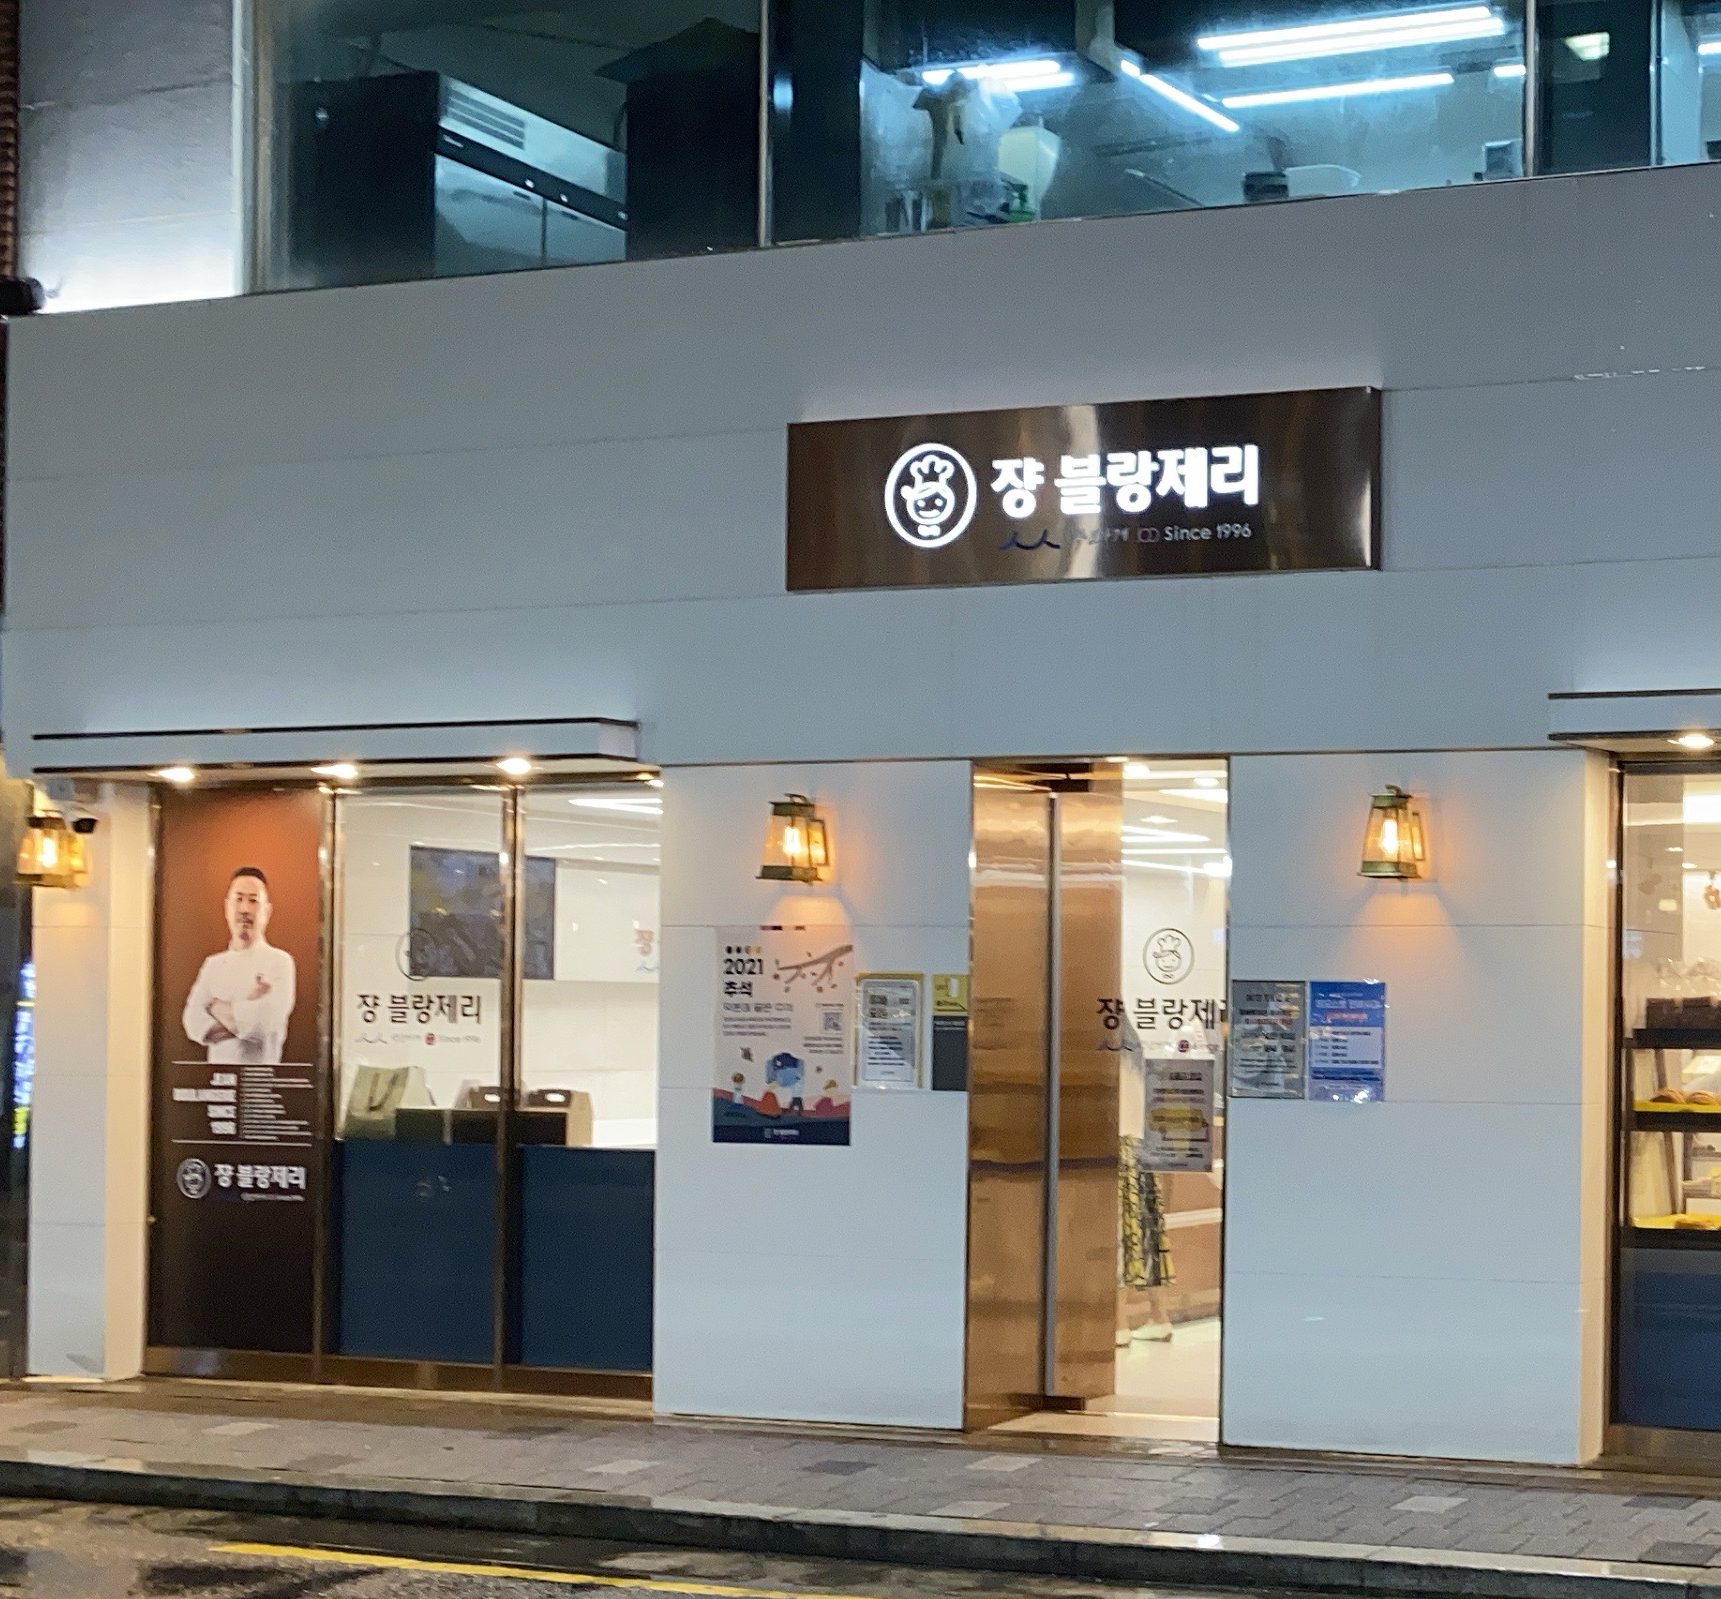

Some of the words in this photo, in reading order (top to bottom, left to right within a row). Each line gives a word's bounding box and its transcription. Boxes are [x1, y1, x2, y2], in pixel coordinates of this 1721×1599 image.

[990, 456, 1045, 519] 쟝
[1053, 444, 1259, 515] 블랑제리
[1164, 525, 1212, 542] Since
[1216, 522, 1252, 539] 1996
[724, 958, 763, 975] 2021
[357, 993, 381, 1023] 쟝
[387, 993, 481, 1024] 블랑제리
[1096, 998, 1125, 1030] 쟝
[235, 1164, 307, 1190] 블랑제리
